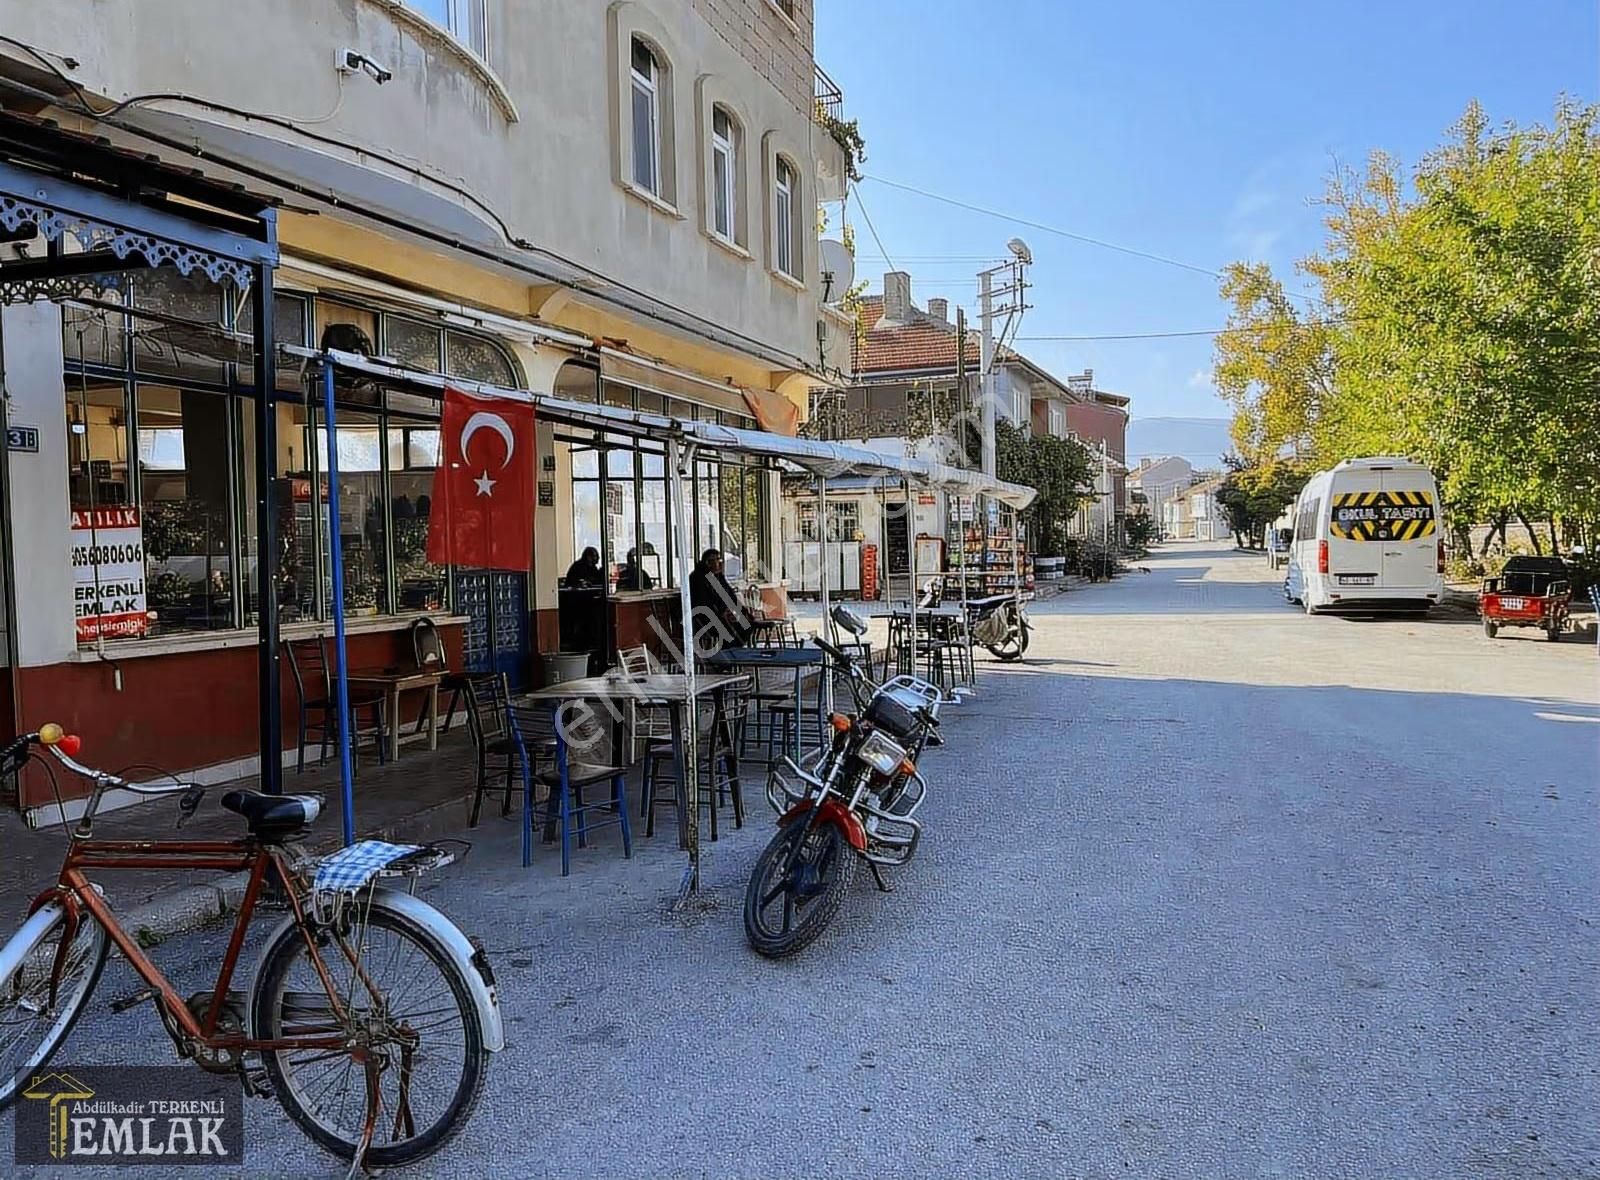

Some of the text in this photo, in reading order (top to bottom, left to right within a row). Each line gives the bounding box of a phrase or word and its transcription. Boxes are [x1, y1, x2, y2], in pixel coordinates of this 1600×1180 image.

[72, 510, 137, 526] ATILIK
[1338, 508, 1378, 520] OKUL
[75, 578, 143, 600] ERKENLİ
